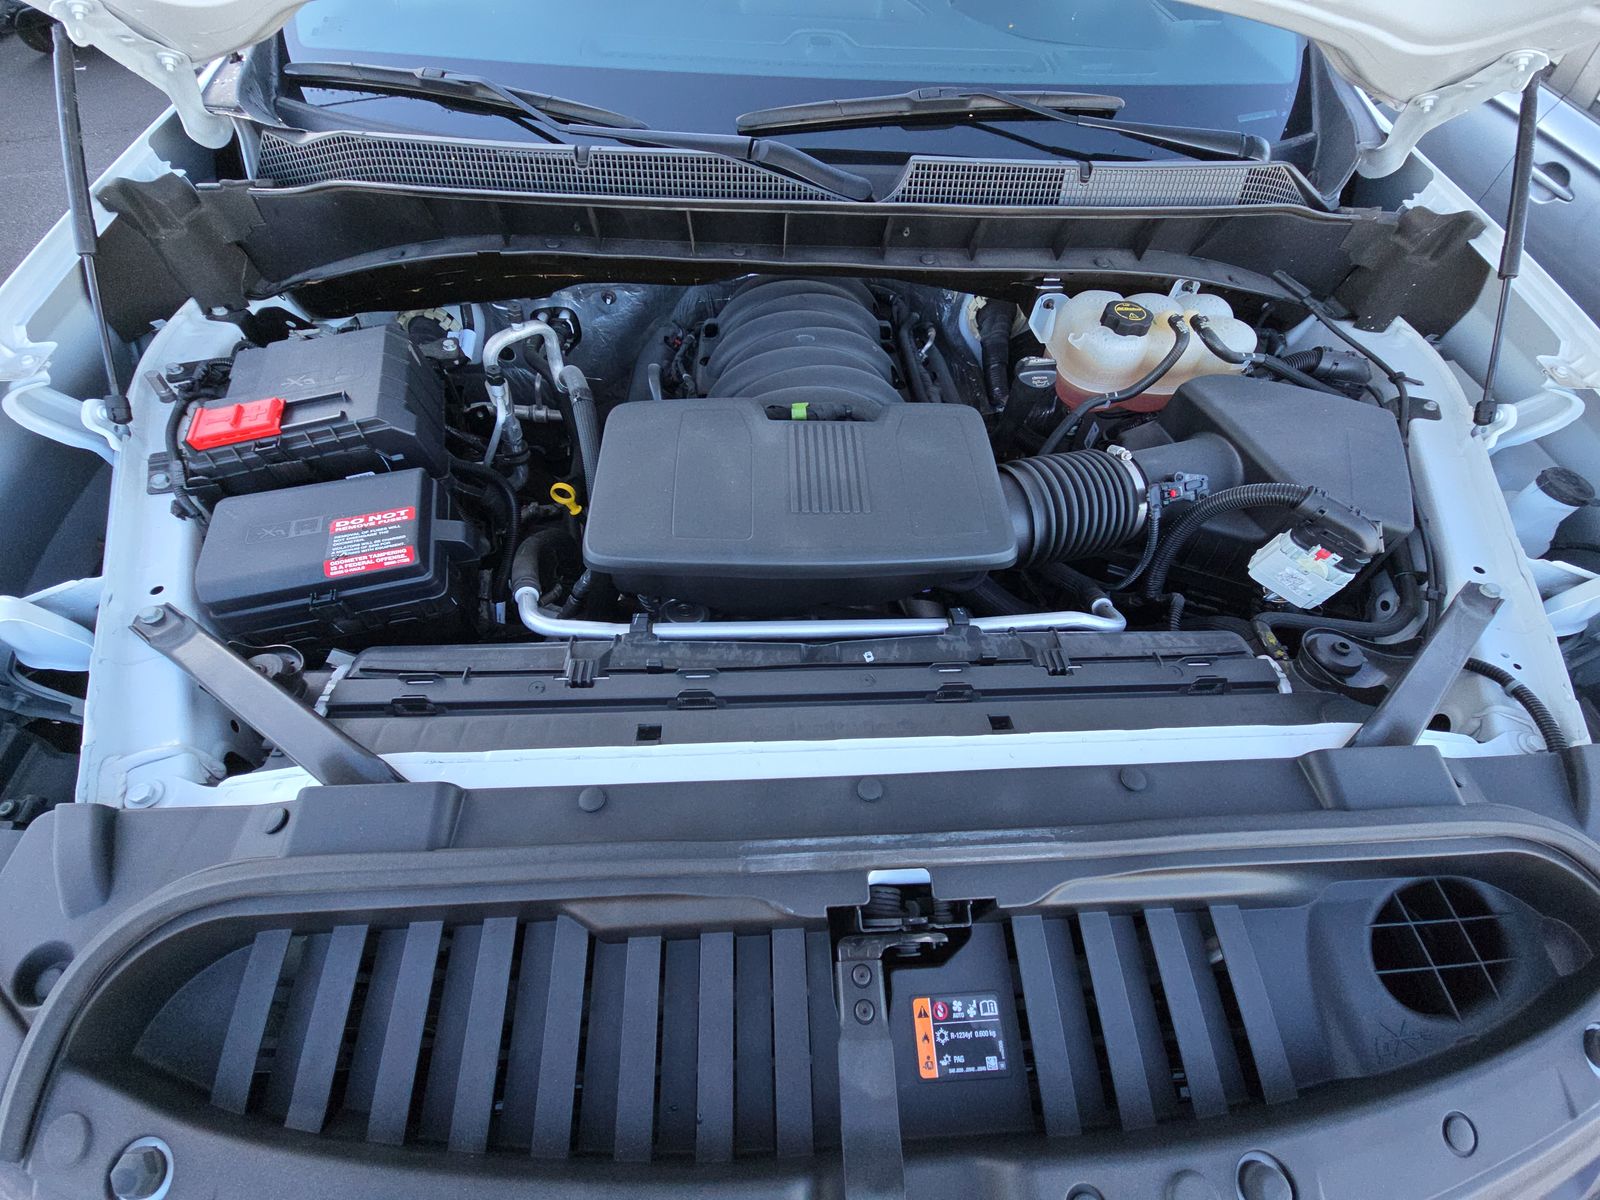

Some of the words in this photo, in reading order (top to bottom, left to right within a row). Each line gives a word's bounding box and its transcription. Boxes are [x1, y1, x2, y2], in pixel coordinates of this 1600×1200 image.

[335, 517, 365, 528] DO
[368, 509, 409, 521] NOT
[335, 521, 375, 532] REMOVE
[377, 515, 409, 525] FUSES
[329, 555, 368, 566] ODOMETER
[368, 548, 407, 559] TAMPERING
[344, 559, 375, 569] FEDERAL
